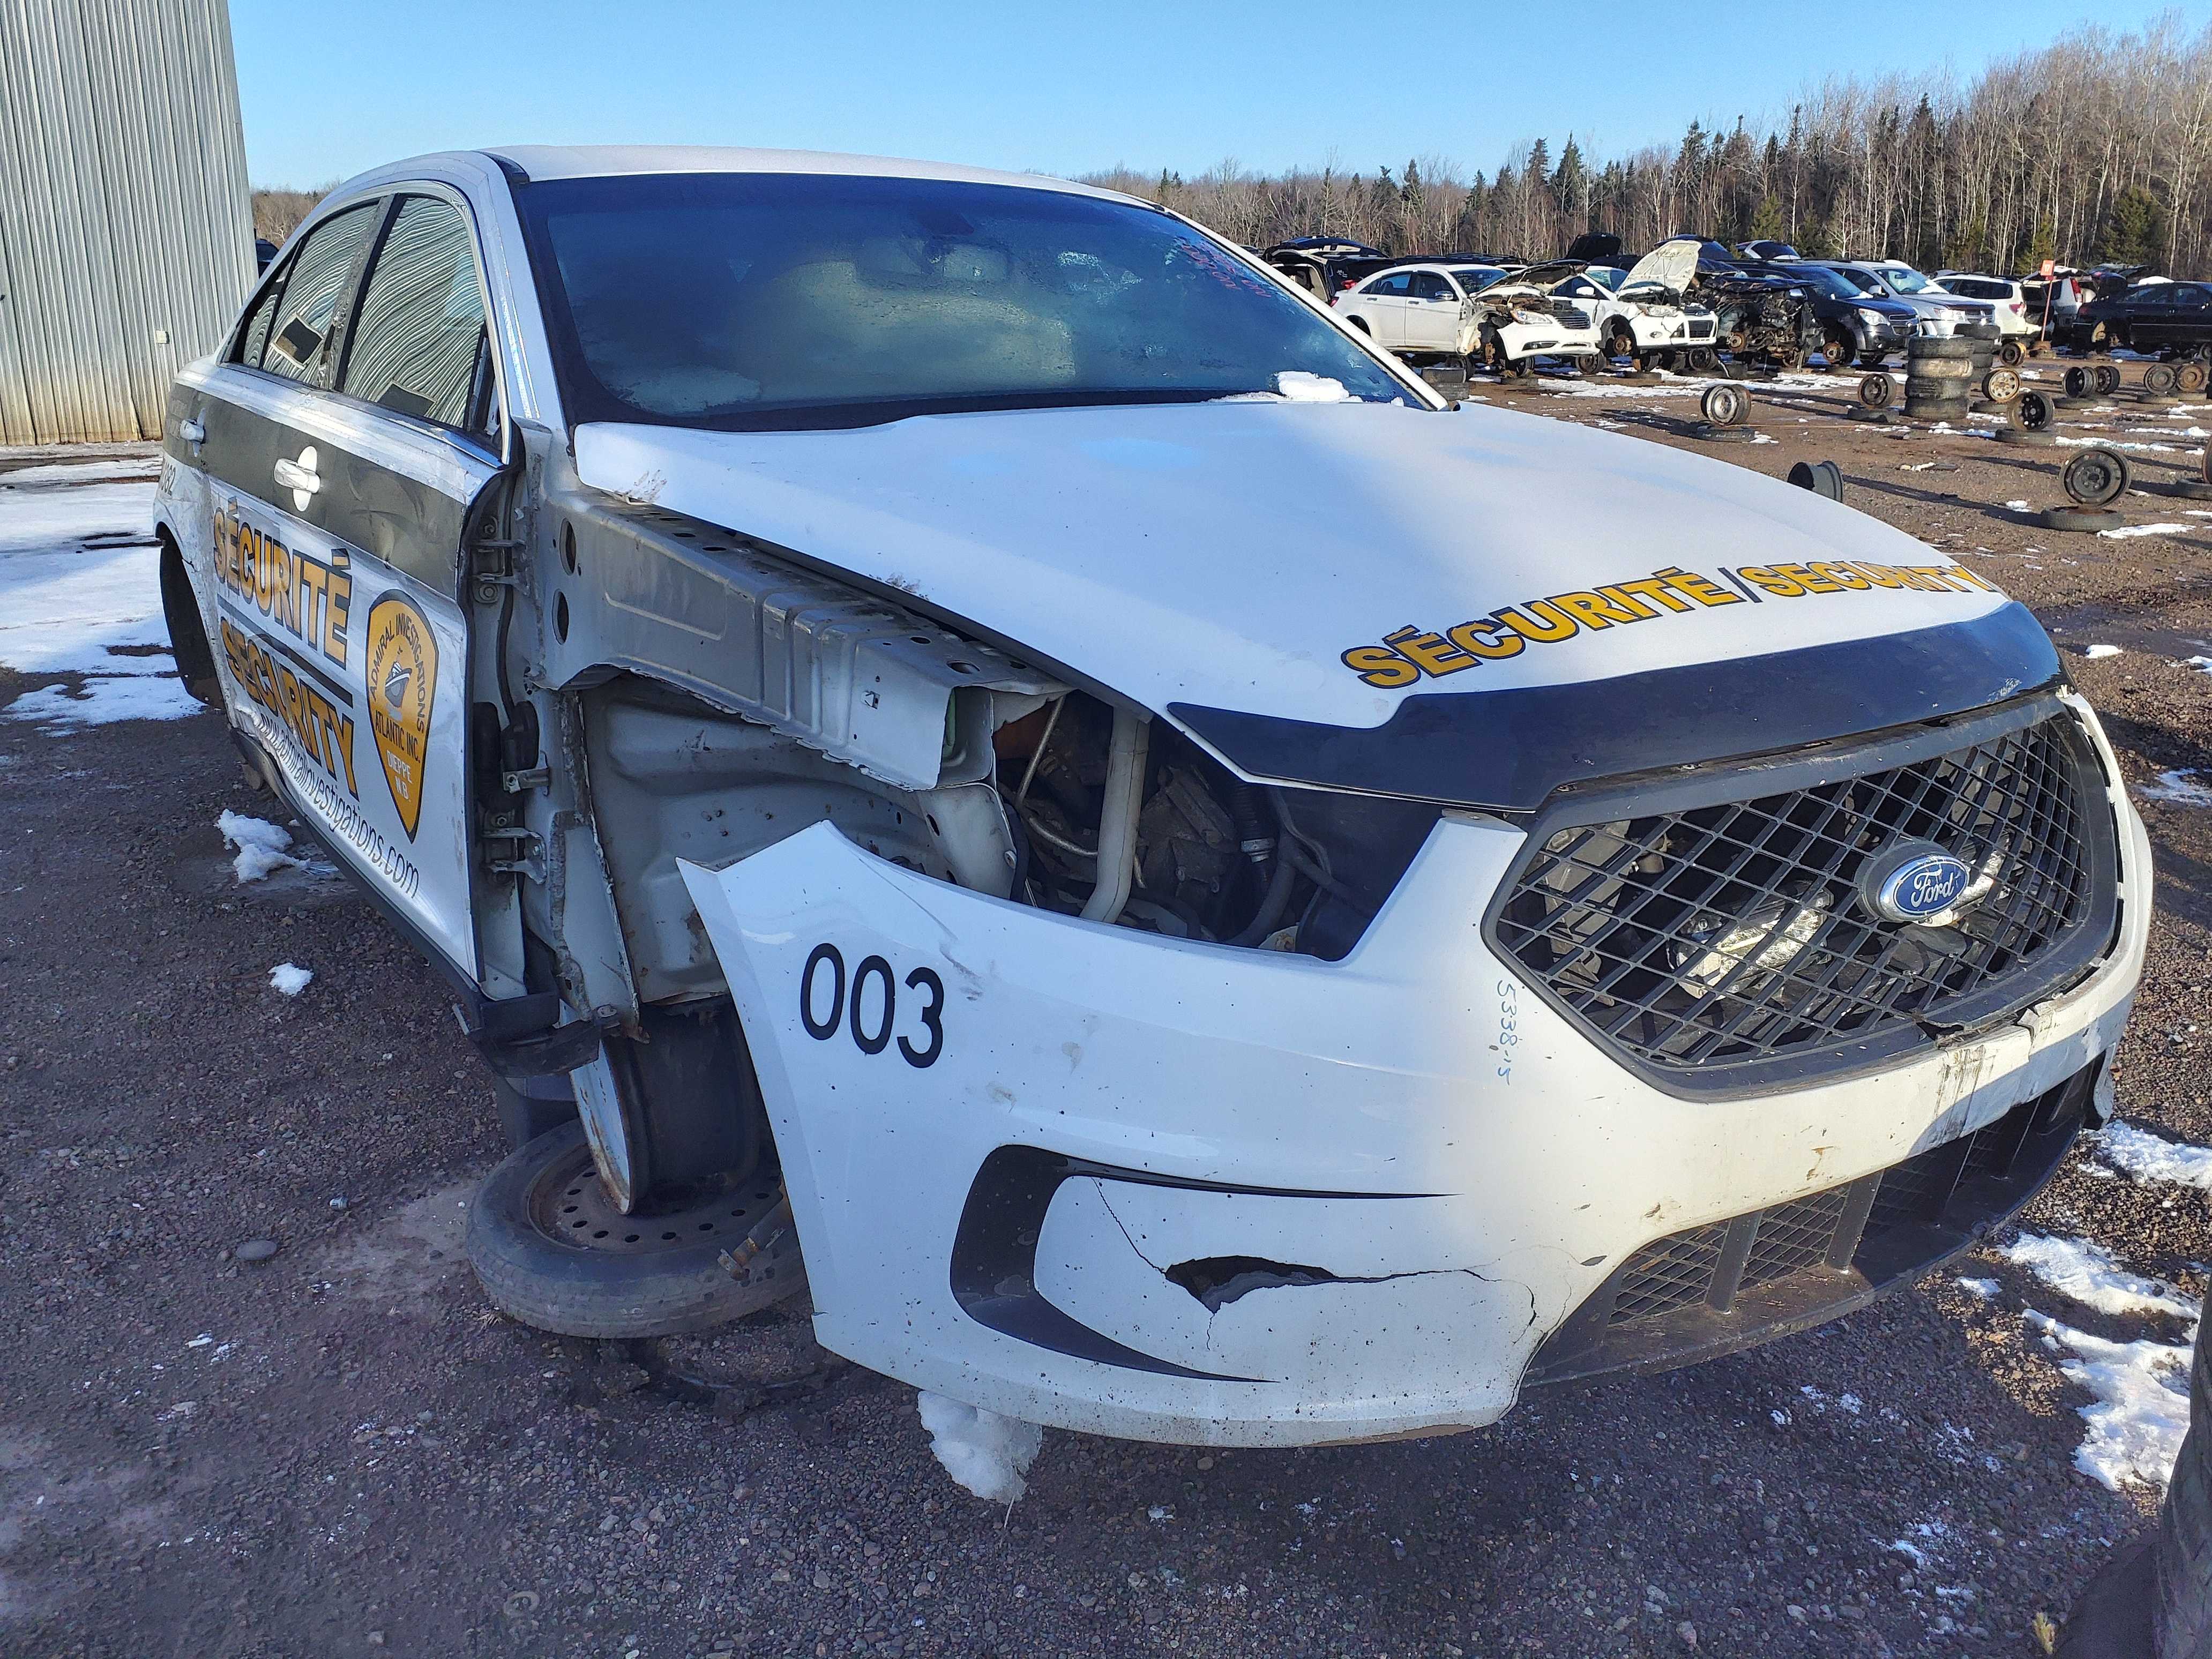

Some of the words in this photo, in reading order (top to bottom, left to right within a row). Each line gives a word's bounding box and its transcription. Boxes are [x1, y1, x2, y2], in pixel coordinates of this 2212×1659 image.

[213, 497, 353, 671] SÉCURITÉ
[220, 616, 360, 802] SECURITY
[370, 620, 394, 701] ADMIRAL
[396, 612, 425, 734] INVESTIGATIONS
[375, 709, 404, 751] ATLANTIC
[406, 731, 421, 764] INC.
[386, 750, 413, 784] DIEPPE
[1910, 869, 1954, 907] Ford
[800, 943, 945, 1068] 003
